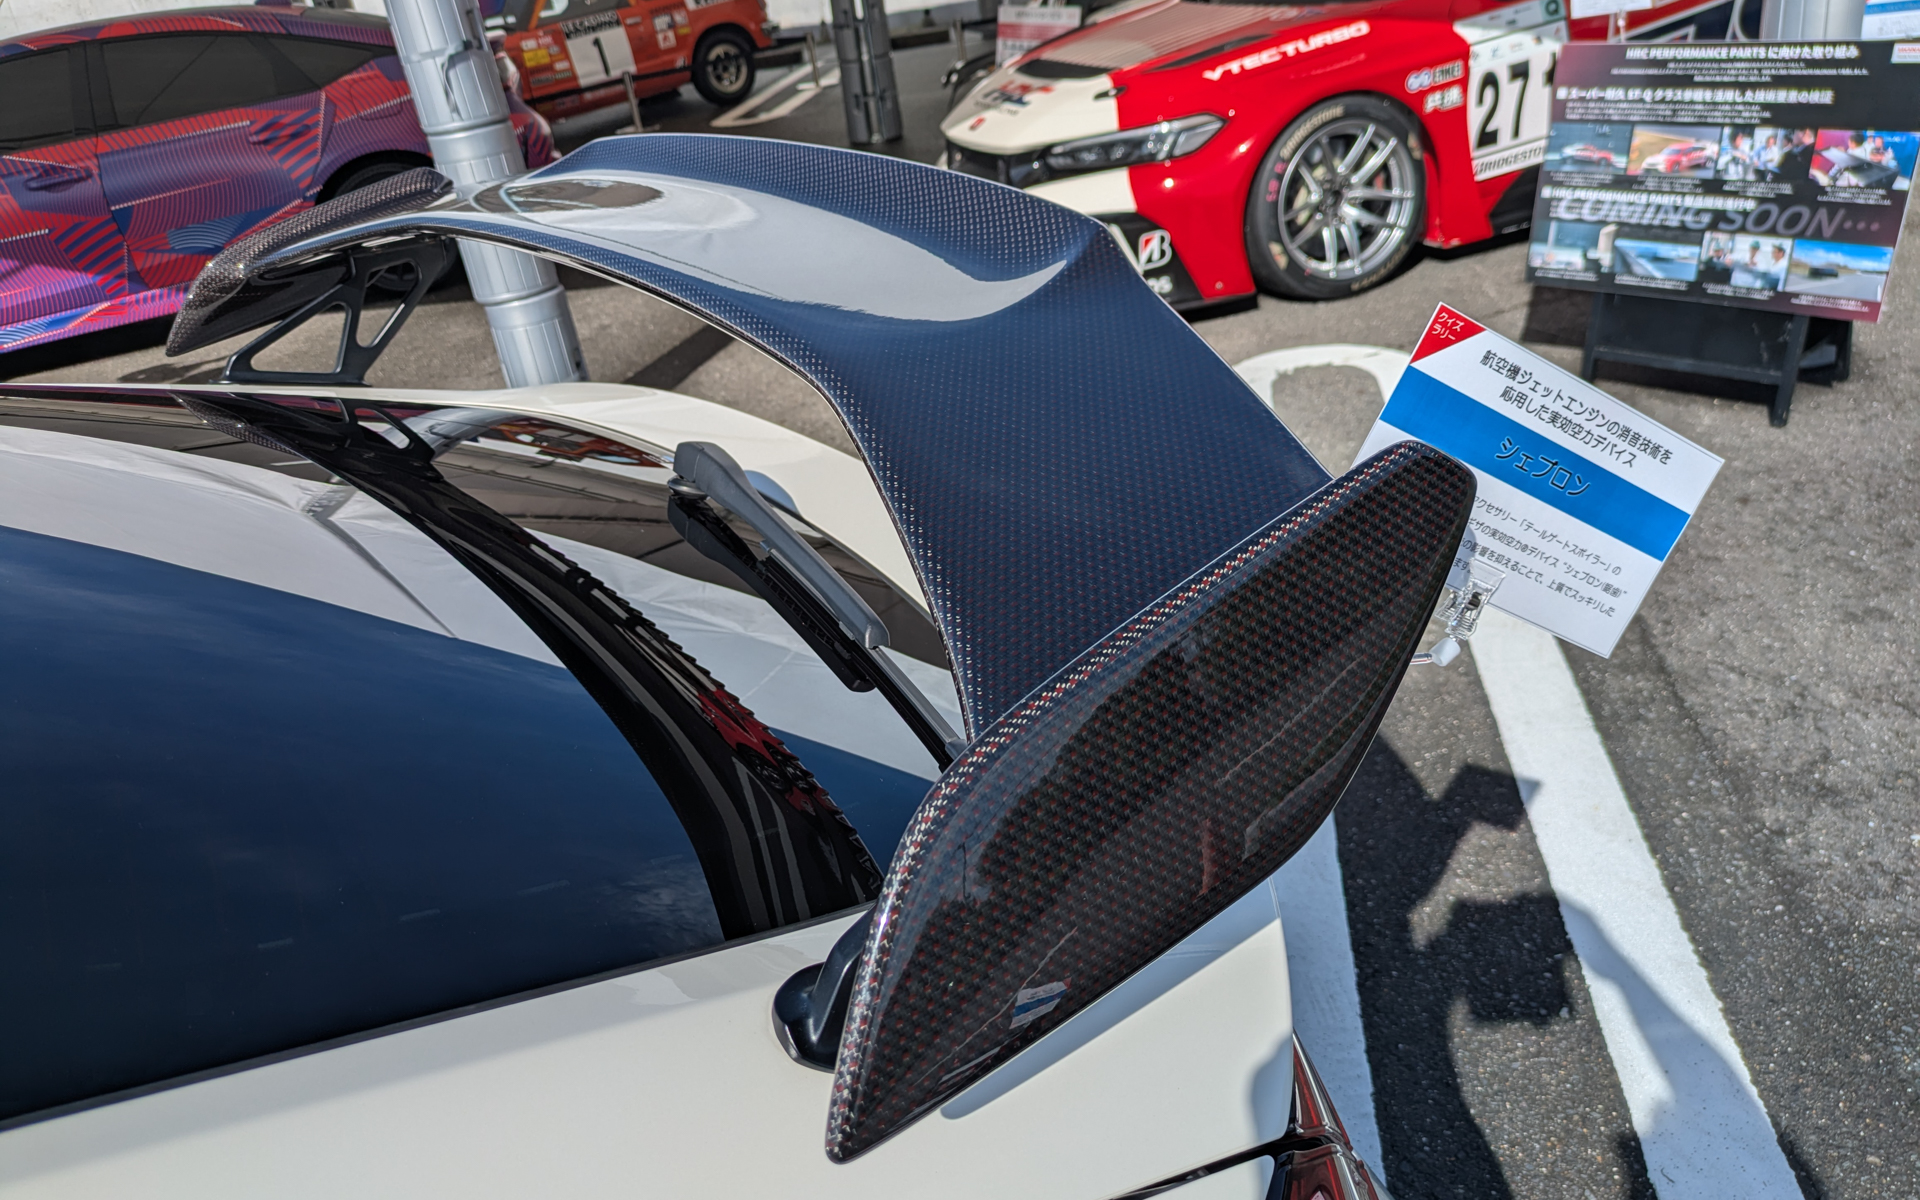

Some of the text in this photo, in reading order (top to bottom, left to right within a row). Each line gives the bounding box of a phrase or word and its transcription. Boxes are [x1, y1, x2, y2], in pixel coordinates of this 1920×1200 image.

[593, 37, 611, 78] 1
[1649, 47, 1729, 60] PERFORMANCE
[1729, 47, 1766, 60] PARTS
[1767, 44, 1860, 60] に向けた取り組み
[1476, 53, 1556, 148] 27
[1475, 147, 1543, 176] BRIDGESTO
[1574, 188, 1650, 204] PERFORMANCE
[1650, 190, 1682, 206] PARTS
[1431, 323, 1456, 340] ラリー
[1438, 312, 1465, 332] クイズ
[1479, 349, 1674, 466] 航空機ジェットエンジンの消音技術を
[1499, 385, 1638, 469] 応用した実効空力デバイス
[1460, 538, 1616, 618] の影響を抑えることで、上質でスッキリした
